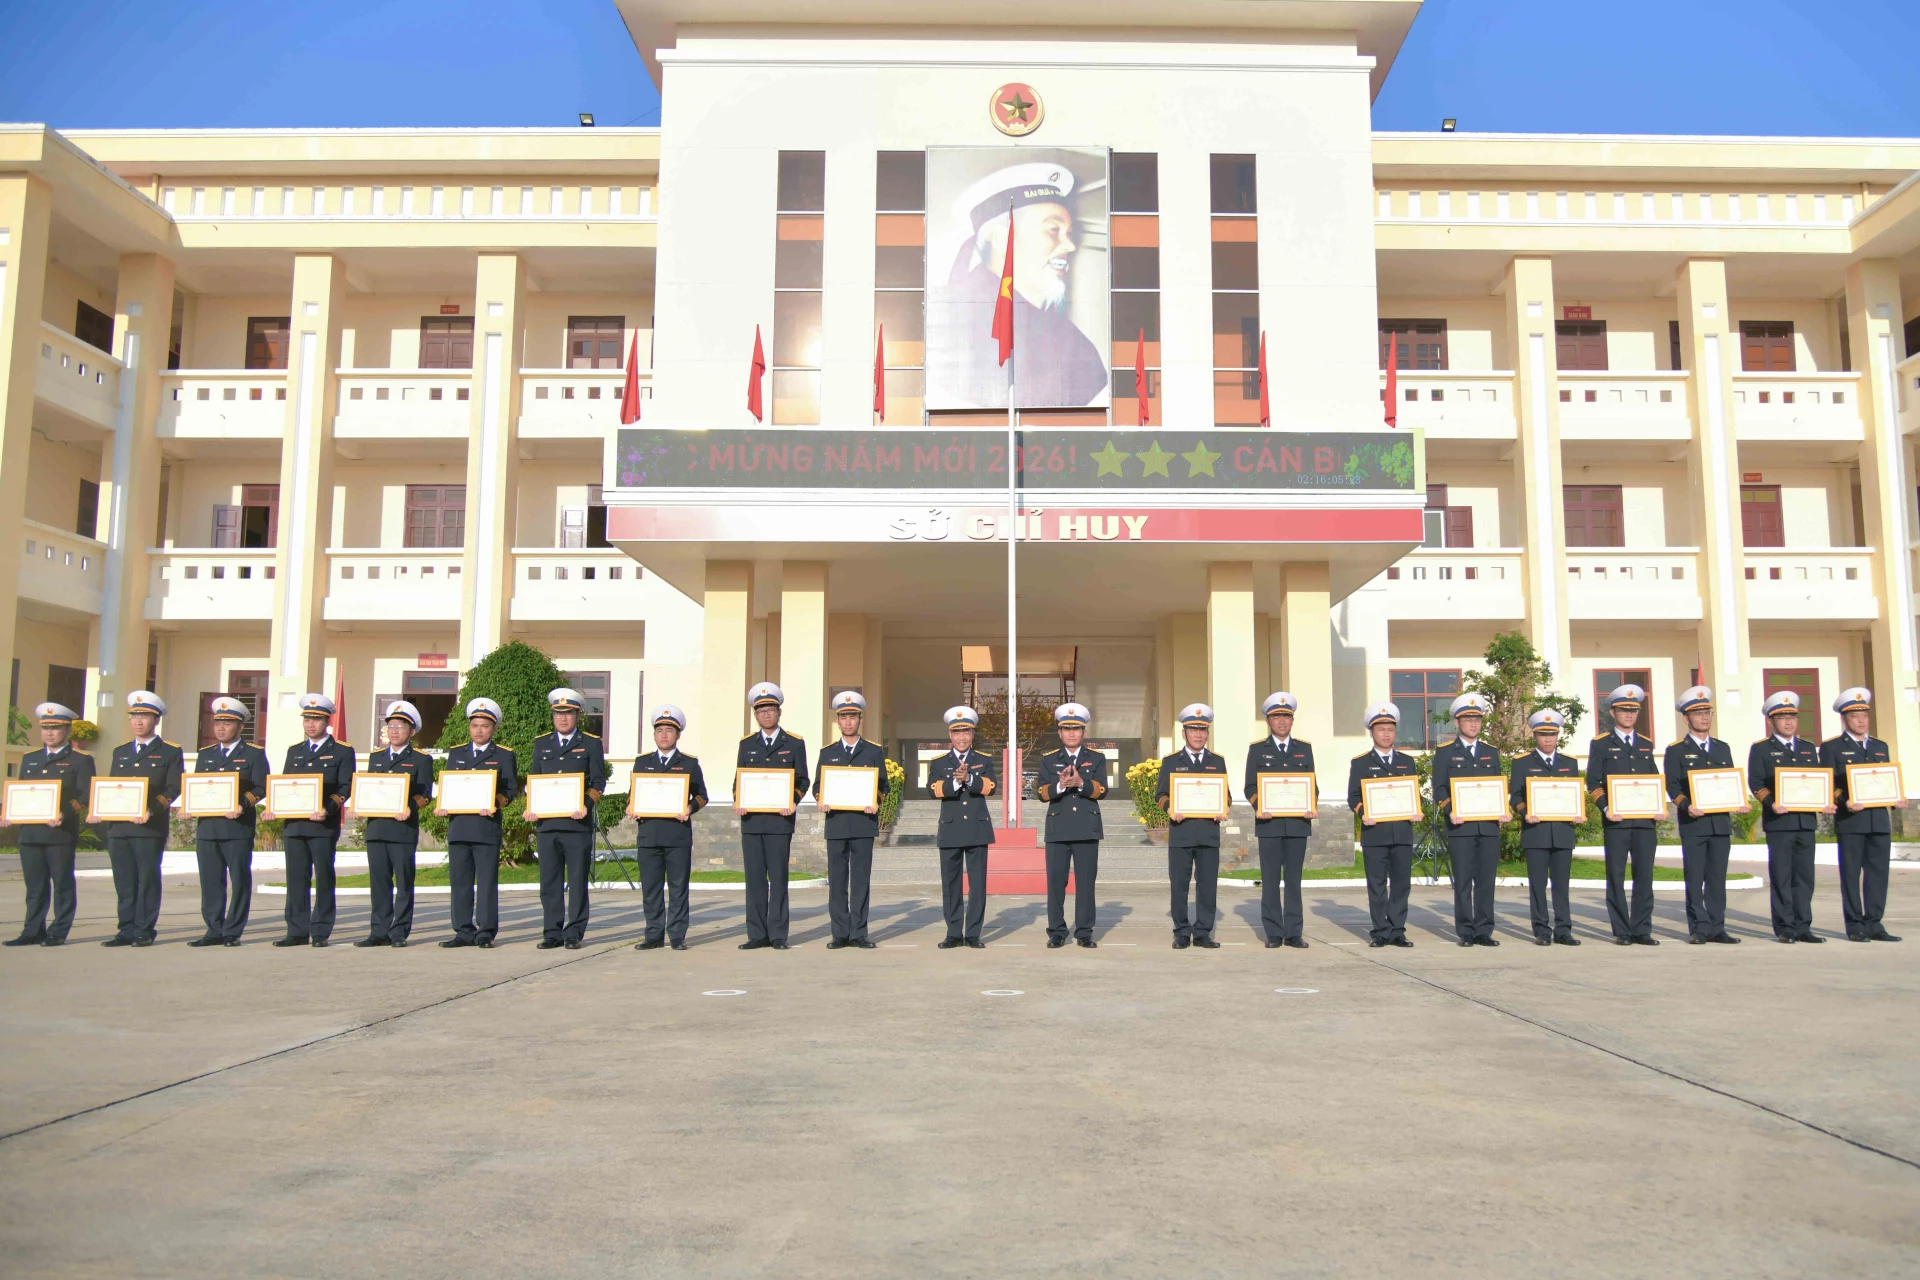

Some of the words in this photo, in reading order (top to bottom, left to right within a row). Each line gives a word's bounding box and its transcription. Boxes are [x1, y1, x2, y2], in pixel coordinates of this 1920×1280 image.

[709, 436, 813, 472] MỪNG
[826, 437, 901, 472] NĂM
[914, 436, 976, 472] MỚI
[1234, 437, 1302, 473] CÁN
[1314, 446, 1341, 473] B
[889, 508, 950, 540] SỞ
[966, 507, 1043, 540] CHỈ
[1059, 515, 1149, 540] HUY
